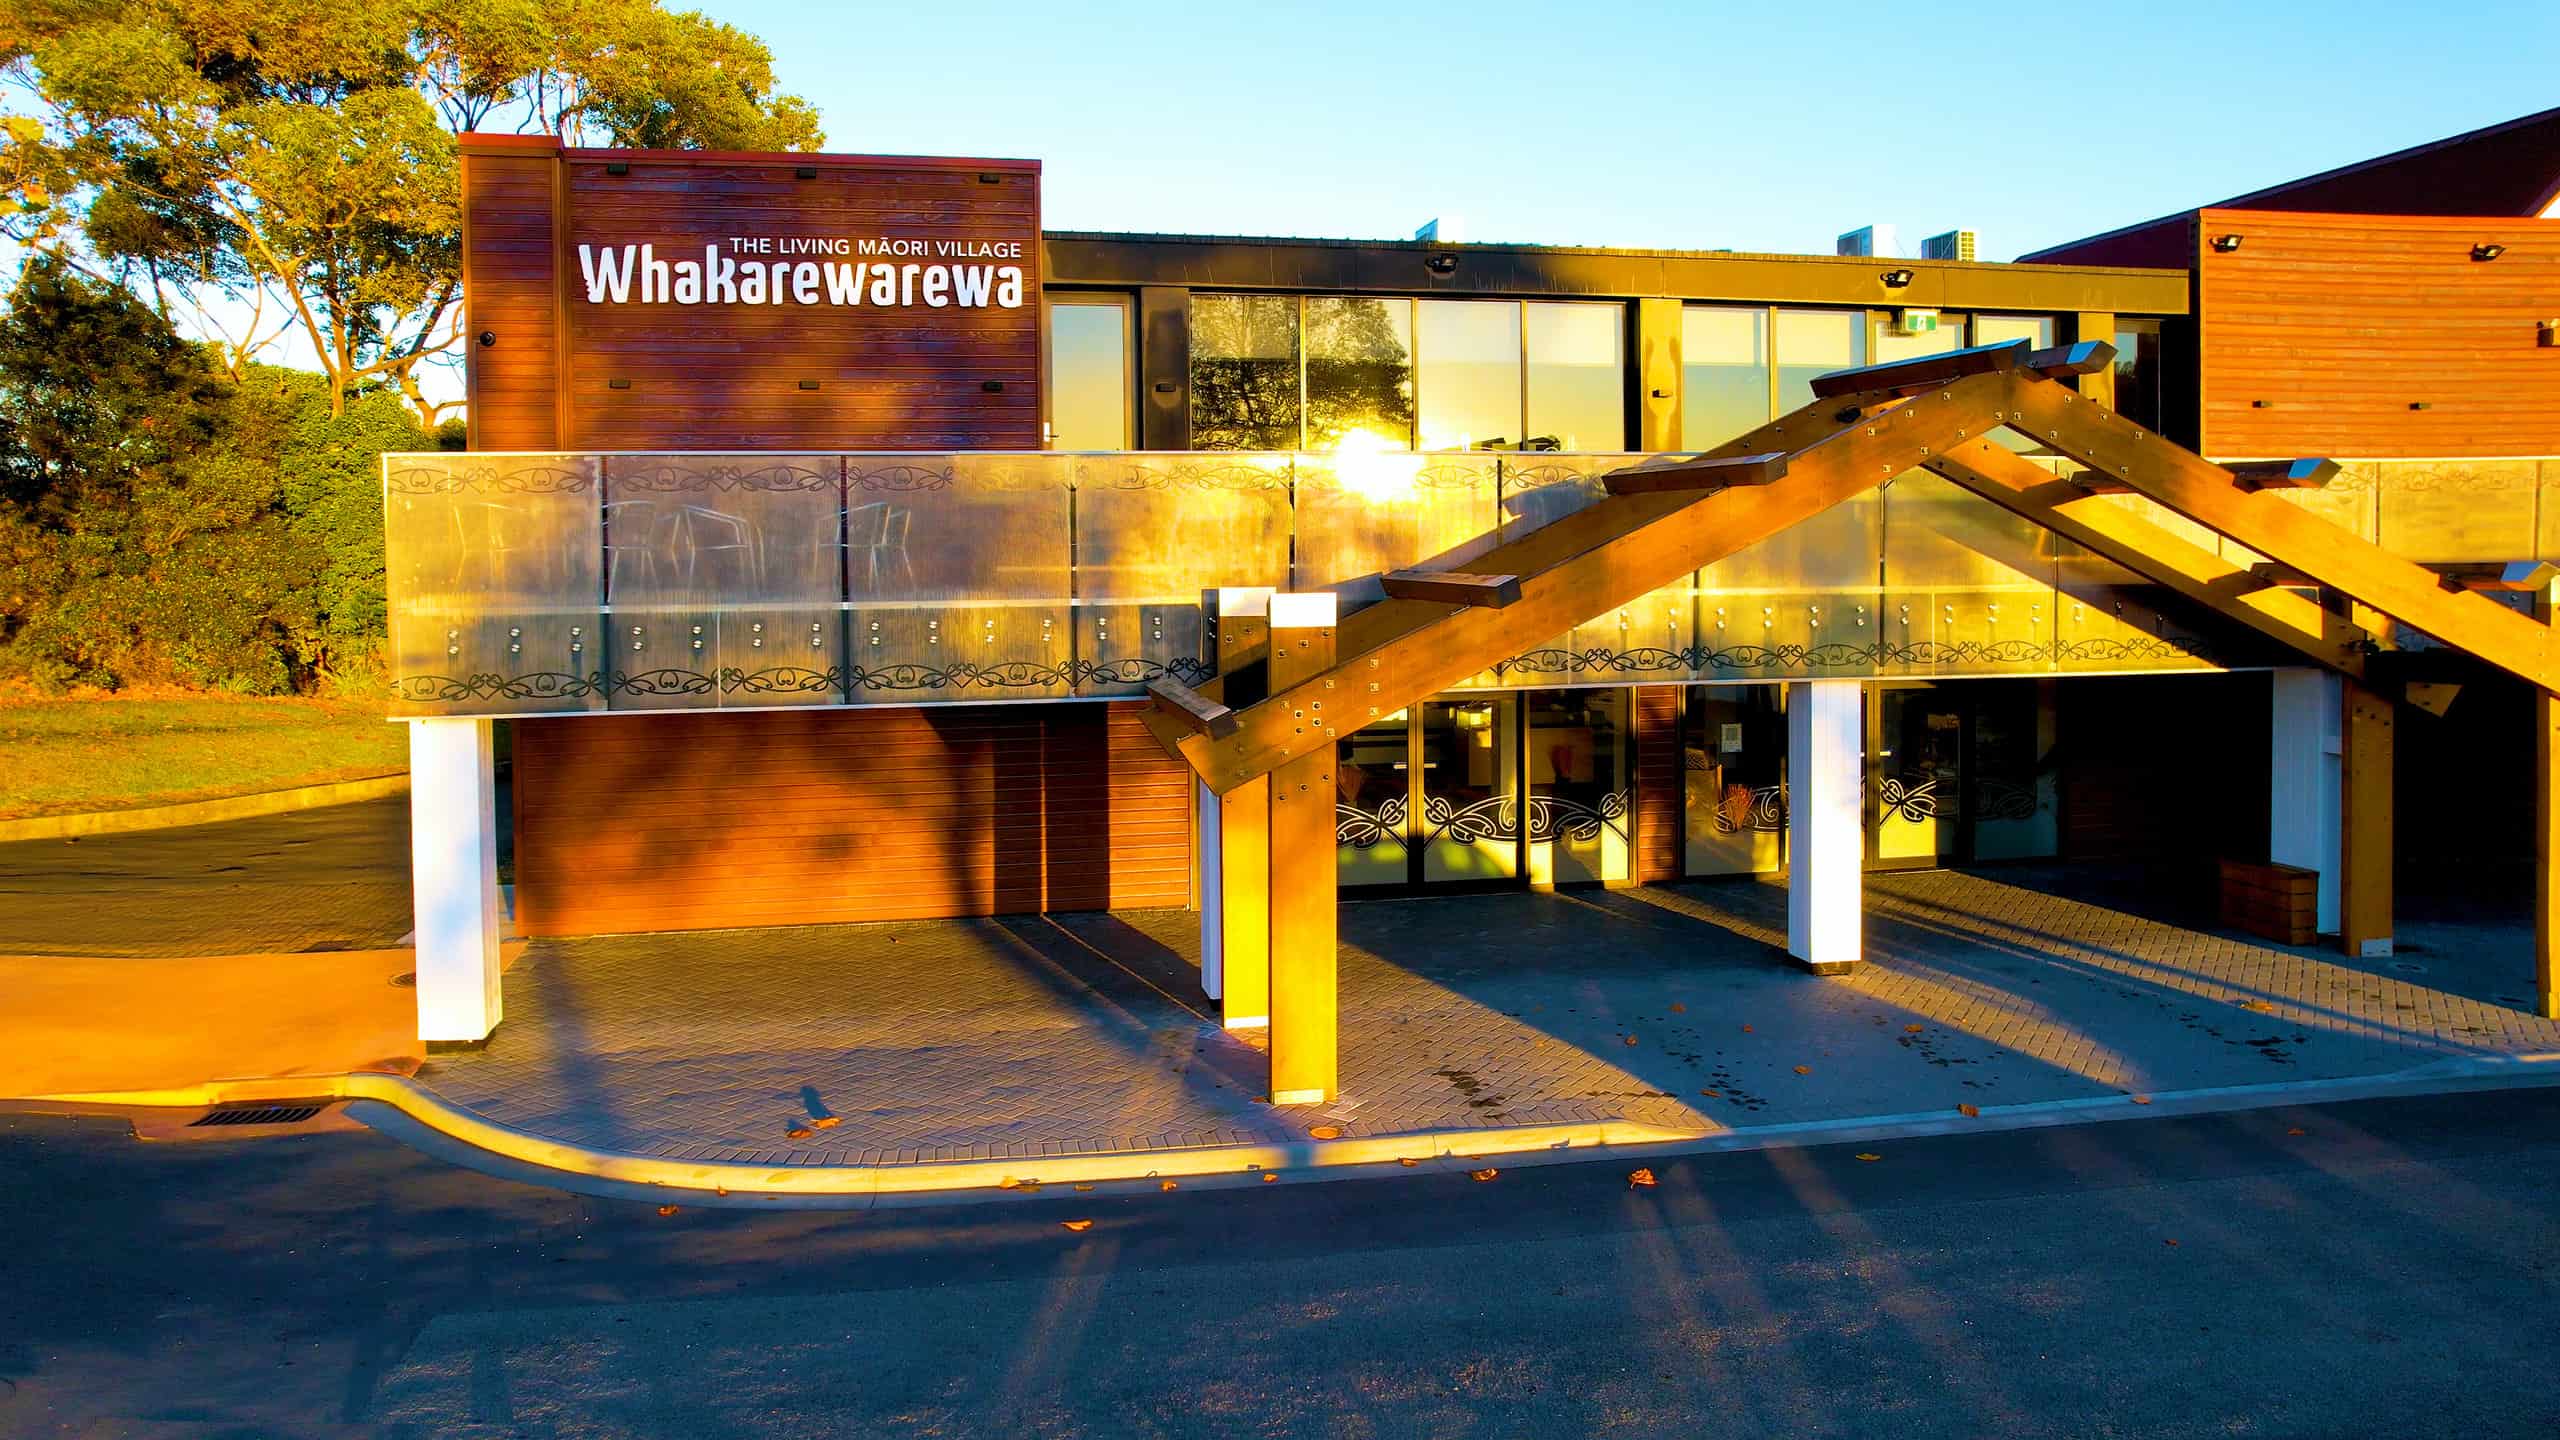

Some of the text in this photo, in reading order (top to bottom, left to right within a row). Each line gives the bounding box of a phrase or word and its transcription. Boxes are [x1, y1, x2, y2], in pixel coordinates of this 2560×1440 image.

[729, 236, 1022, 259] THE LIVING MĀORI VILLAGE
[578, 243, 1024, 308] Whakarewarewa
